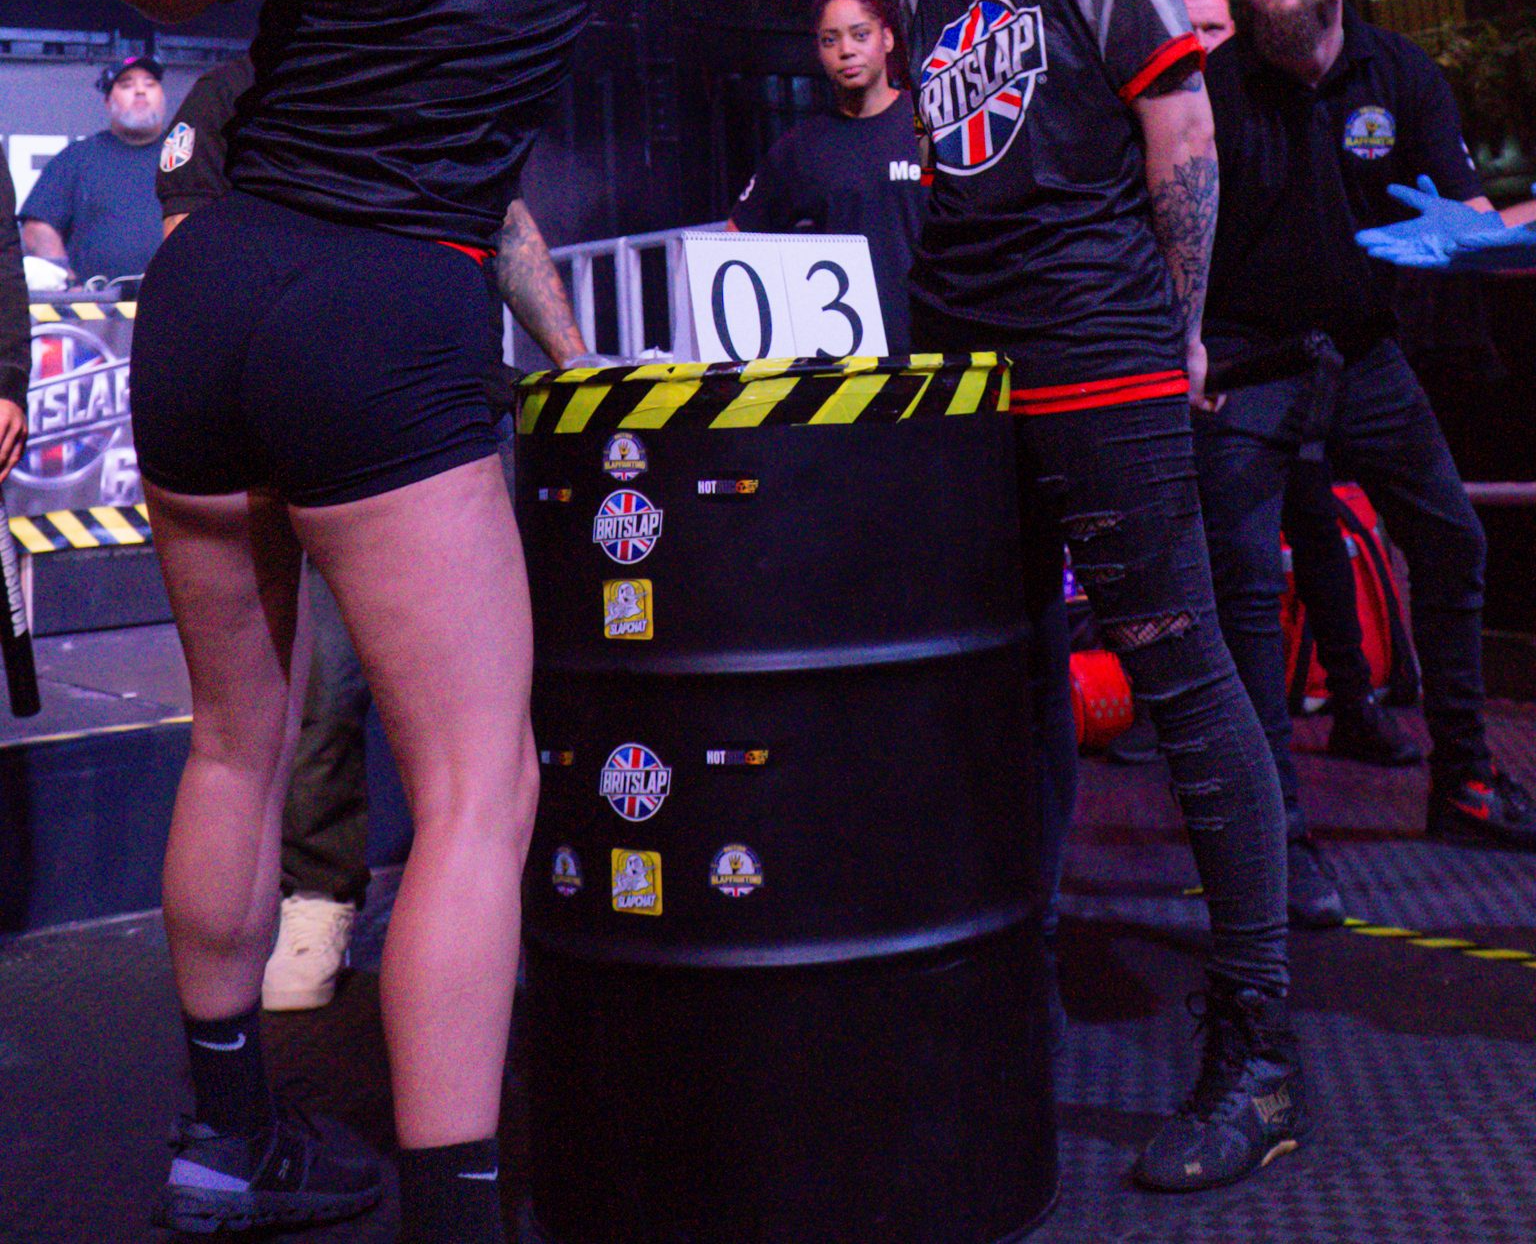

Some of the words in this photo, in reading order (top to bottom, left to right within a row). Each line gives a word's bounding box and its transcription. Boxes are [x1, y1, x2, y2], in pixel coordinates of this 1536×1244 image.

[919, 12, 1035, 129] RITSLAP
[595, 513, 660, 540] BRITSLAP
[609, 619, 648, 636] SLAPCHAT
[602, 770, 667, 794] BRITSLAP
